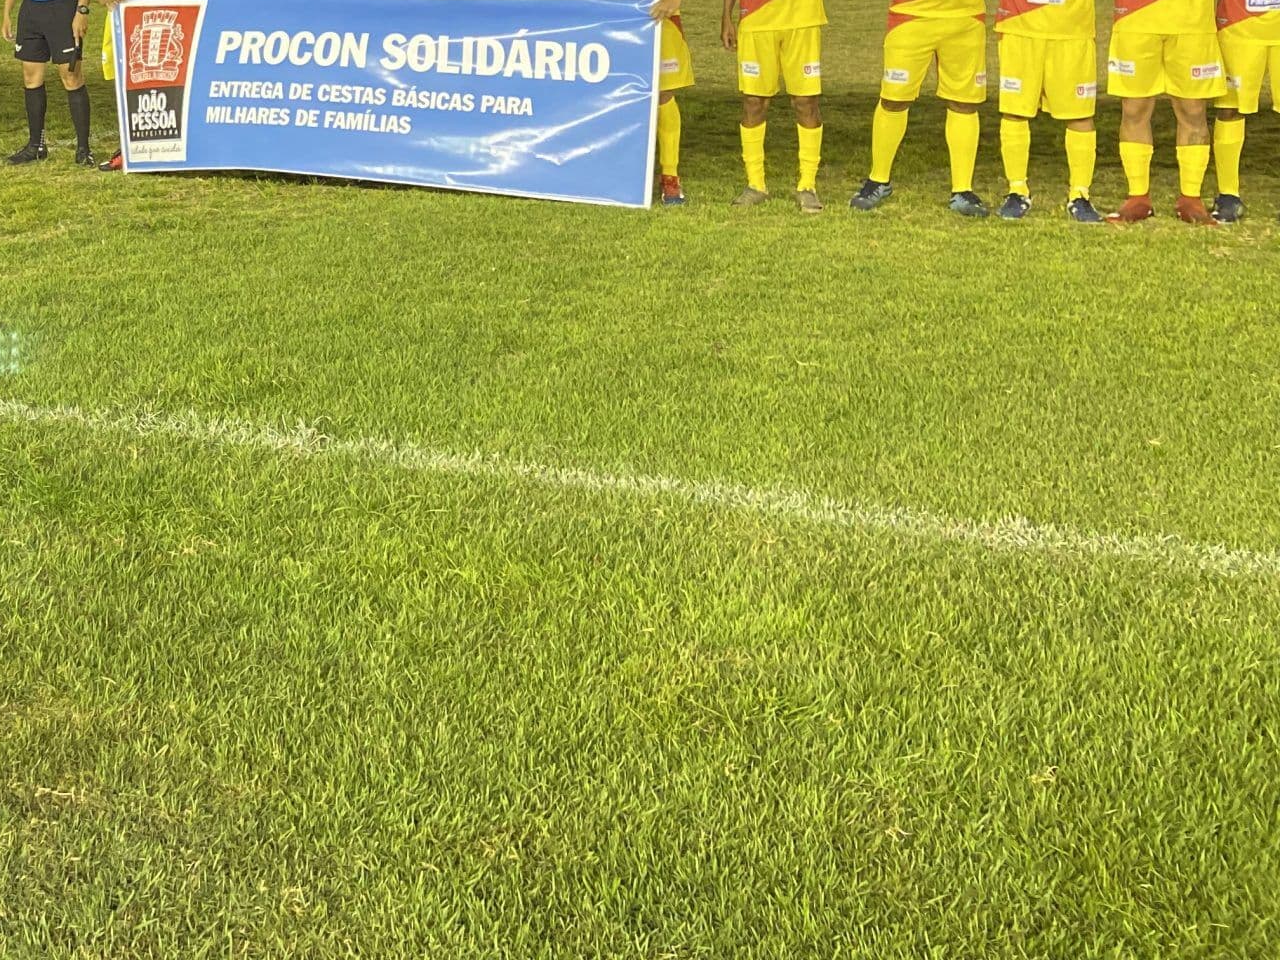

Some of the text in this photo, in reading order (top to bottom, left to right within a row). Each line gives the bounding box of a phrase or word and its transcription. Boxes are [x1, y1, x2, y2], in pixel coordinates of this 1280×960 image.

[215, 29, 610, 83] PROCON SOLIDÁRIO
[137, 89, 167, 113] JOÃO
[209, 80, 533, 116] ENTREGA DE CESTAS BÁSICAS PARA
[131, 109, 177, 131] PESSOA
[206, 106, 412, 135] MILHARES DE FAMÍLIAS
